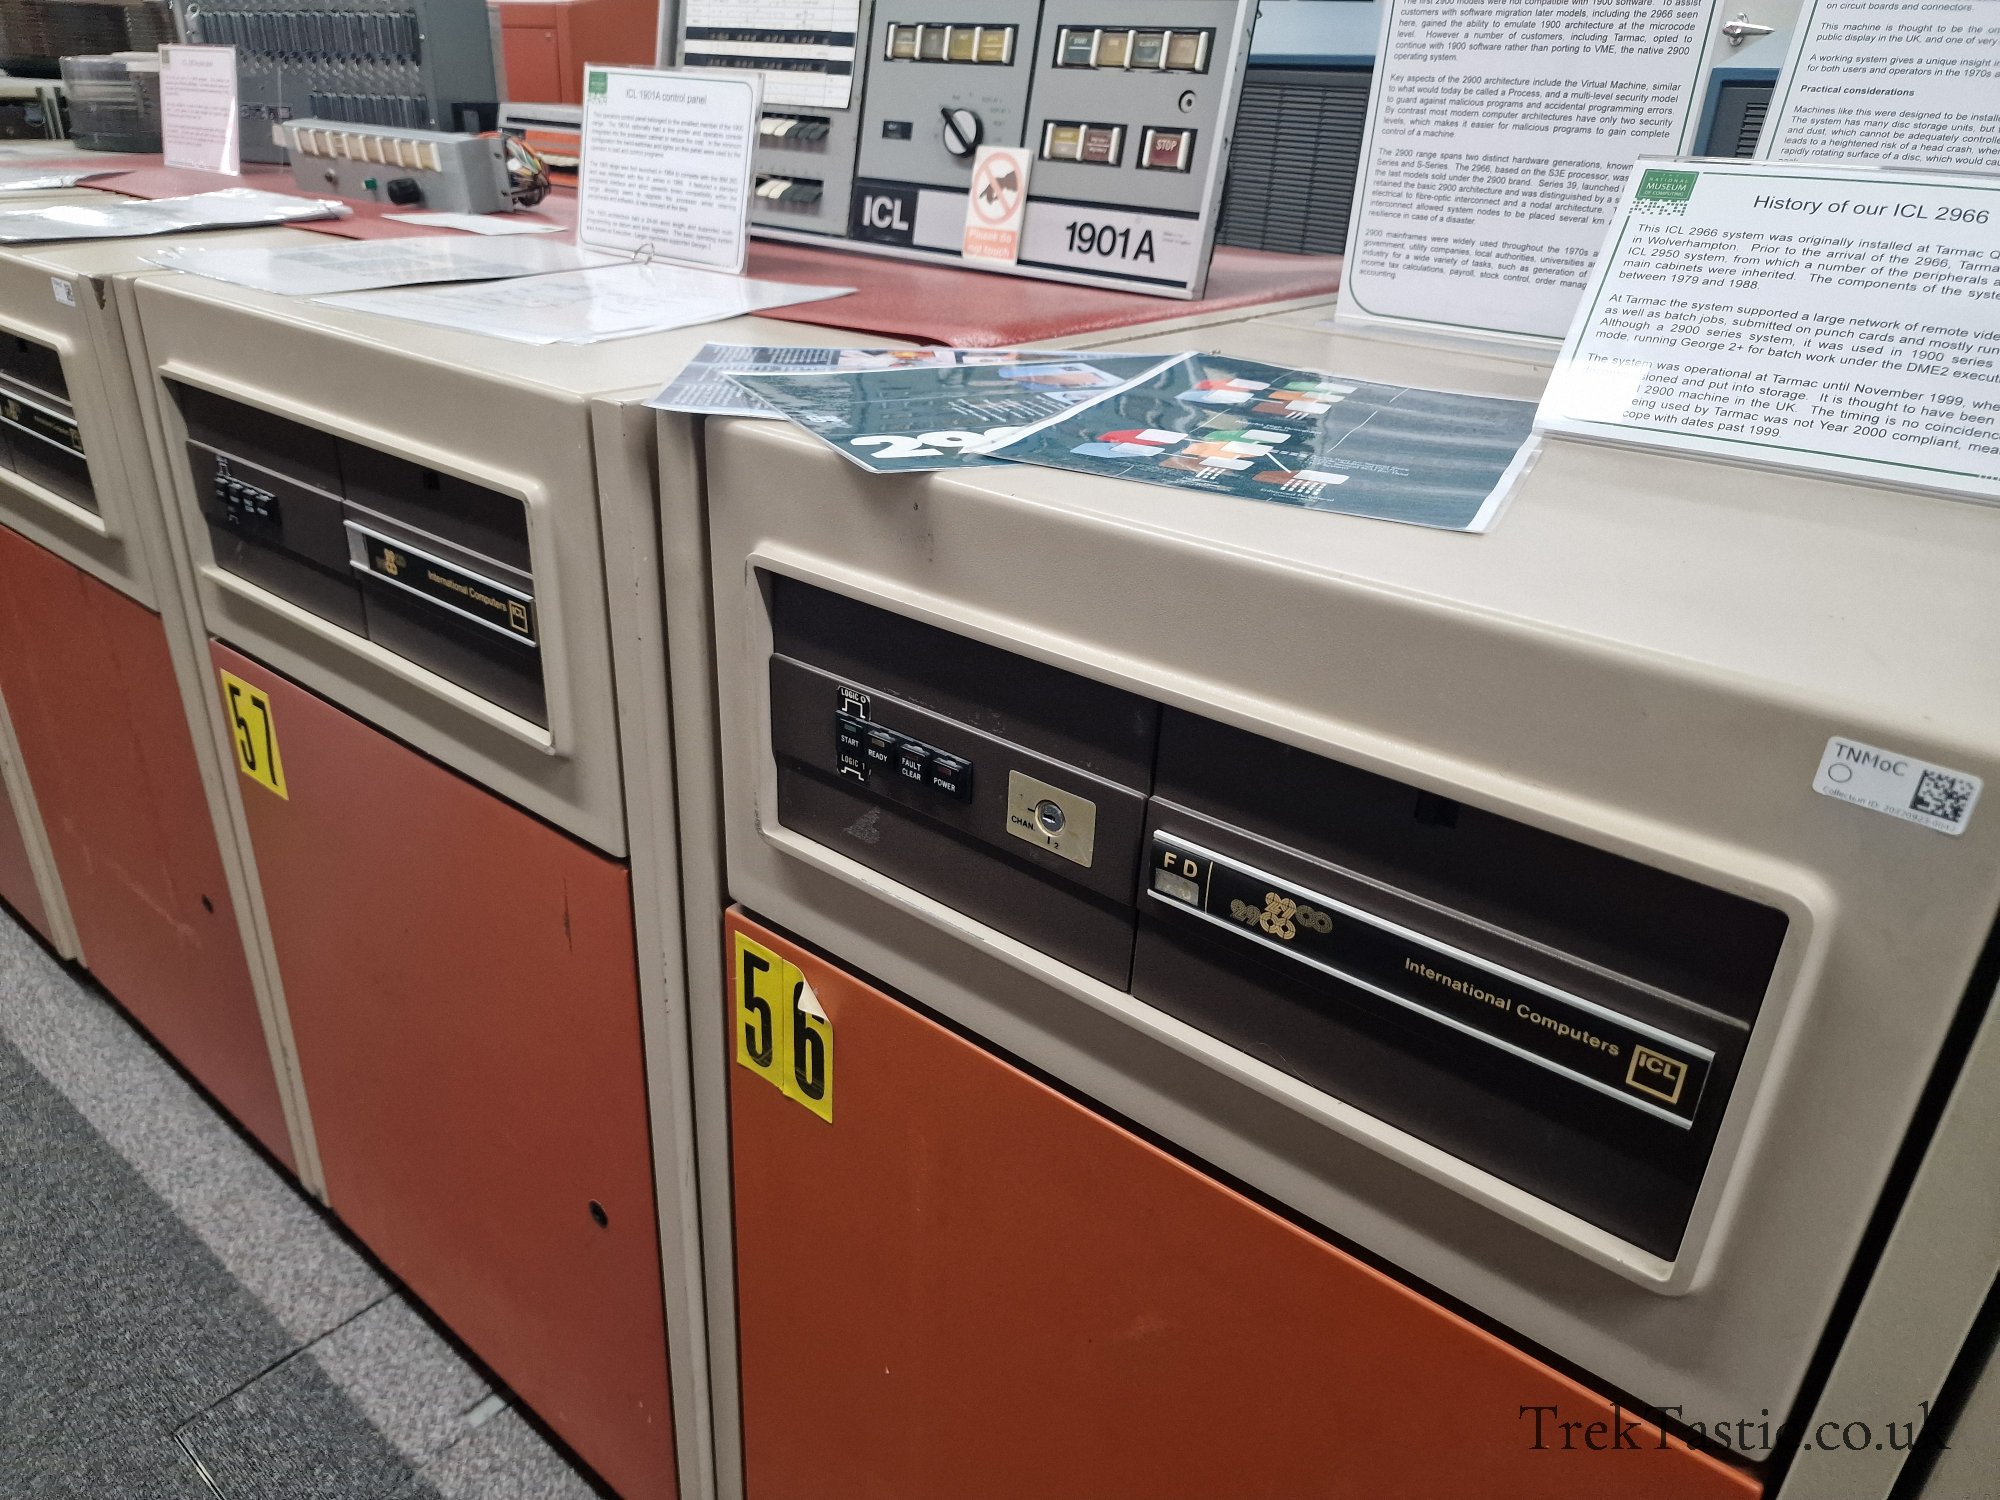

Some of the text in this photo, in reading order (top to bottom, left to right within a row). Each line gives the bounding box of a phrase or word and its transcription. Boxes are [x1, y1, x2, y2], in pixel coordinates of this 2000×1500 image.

[1839, 1, 1867, 11] circuit
[1868, 1, 1900, 11] boards
[1901, 2, 1920, 11] and
[1400, 8, 1439, 17] customers
[1442, 8, 1457, 17] with
[1460, 8, 1493, 18] software
[1495, 8, 1533, 20] migration
[1534, 9, 1554, 18] later
[1592, 9, 1631, 21] including
[1633, 9, 1648, 19] the
[1649, 10, 1674, 19] 2966
[1676, 11, 1699, 19] seen
[1421, 19, 1447, 30] gained
[1450, 19, 1463, 28] the
[1466, 19, 1489, 31] ability
[1492, 19, 1501, 29] to
[1504, 20, 1536, 29] emulate
[1541, 20, 1562, 30] 1900
[1564, 21, 1615, 30] architecture
[1617, 21, 1628, 30] at
[1631, 21, 1646, 31] the
[1648, 22, 1696, 31] microcode
[1815, 32, 1843, 43] public
[1844, 32, 1877, 45] display
[1877, 33, 1887, 43] in
[1888, 33, 1904, 43] the
[1925, 35, 1944, 44] and
[1945, 37, 1964, 45] one
[1965, 36, 1976, 45] of
[1393, 52, 1428, 63] operating
[1390, 73, 1404, 85] Key
[1406, 74, 1435, 86] aspects
[1437, 75, 1446, 84] of
[1447, 75, 1460, 85] the
[1462, 75, 1482, 85] 2900
[1484, 77, 1530, 87] architecture
[1532, 78, 1562, 88] include
[1564, 79, 1578, 88] the
[1581, 79, 1608, 89] Virtual
[1651, 82, 1682, 92] similar
[1800, 84, 1915, 97] Practical considerations
[626, 89, 708, 105] ICL 1901A control panel
[1791, 115, 1808, 125] The
[1810, 116, 1842, 128] system
[1844, 117, 1861, 127] has
[1863, 120, 1890, 131] many
[1891, 119, 1911, 130] disc
[1912, 121, 1949, 133] storage
[1979, 123, 1996, 134] but
[1156, 139, 1178, 151] STOP
[1646, 183, 1687, 191] MUSEUM
[861, 195, 910, 232] ICL
[1753, 194, 1990, 223] History of our ICL 2966
[1065, 221, 1156, 264] 1901A
[1638, 223, 1661, 235] This
[1665, 224, 1684, 237] ICL
[1688, 226, 1718, 239] 2966
[1722, 230, 1764, 243] system
[1767, 234, 1793, 244] was
[1798, 235, 1854, 251] originally
[1858, 238, 1913, 253] installed
[1916, 243, 1930, 254] at
[1936, 244, 1984, 258] Tarmac
[1618, 270, 1667, 284] between
[1671, 274, 1699, 287] 1979
[1701, 277, 1725, 288] and
[1608, 292, 1622, 305] At
[1626, 294, 1667, 309] Tarmac
[1667, 298, 1688, 311] the
[1691, 302, 1734, 315] system
[1736, 307, 1799, 321] supported
[1801, 313, 1810, 322] a
[1813, 312, 1845, 328] large
[1848, 316, 1901, 331] network
[1904, 321, 1919, 333] of
[1921, 324, 1969, 337] remote
[1588, 350, 1608, 363] The
[1613, 355, 1652, 369] system
[1657, 361, 1680, 372] was
[1684, 364, 1752, 381] operational
[1754, 371, 1768, 383] at
[1773, 373, 1819, 389] Tarmac
[1822, 380, 1850, 393] until
[1853, 383, 1925, 402] November
[1654, 412, 1678, 425] with
[1681, 414, 1714, 429] dates
[1717, 421, 1745, 434] past
[427, 570, 508, 612] International Computers
[511, 605, 525, 619] ICL
[841, 687, 859, 701] LOGIC
[228, 682, 279, 787] 57
[841, 734, 859, 748] START
[841, 754, 859, 767] LOGIC
[868, 748, 888, 762] READY
[1835, 743, 1909, 777] TNMoC
[901, 757, 921, 771] FAULT
[901, 768, 921, 781] CLEAR
[934, 777, 956, 792] POWER
[1011, 815, 1036, 831] CHAN.
[1164, 851, 1198, 878] F D
[1404, 957, 1620, 1057] International Computers
[743, 949, 825, 1101] 56
[1637, 1053, 1677, 1082] ICL
